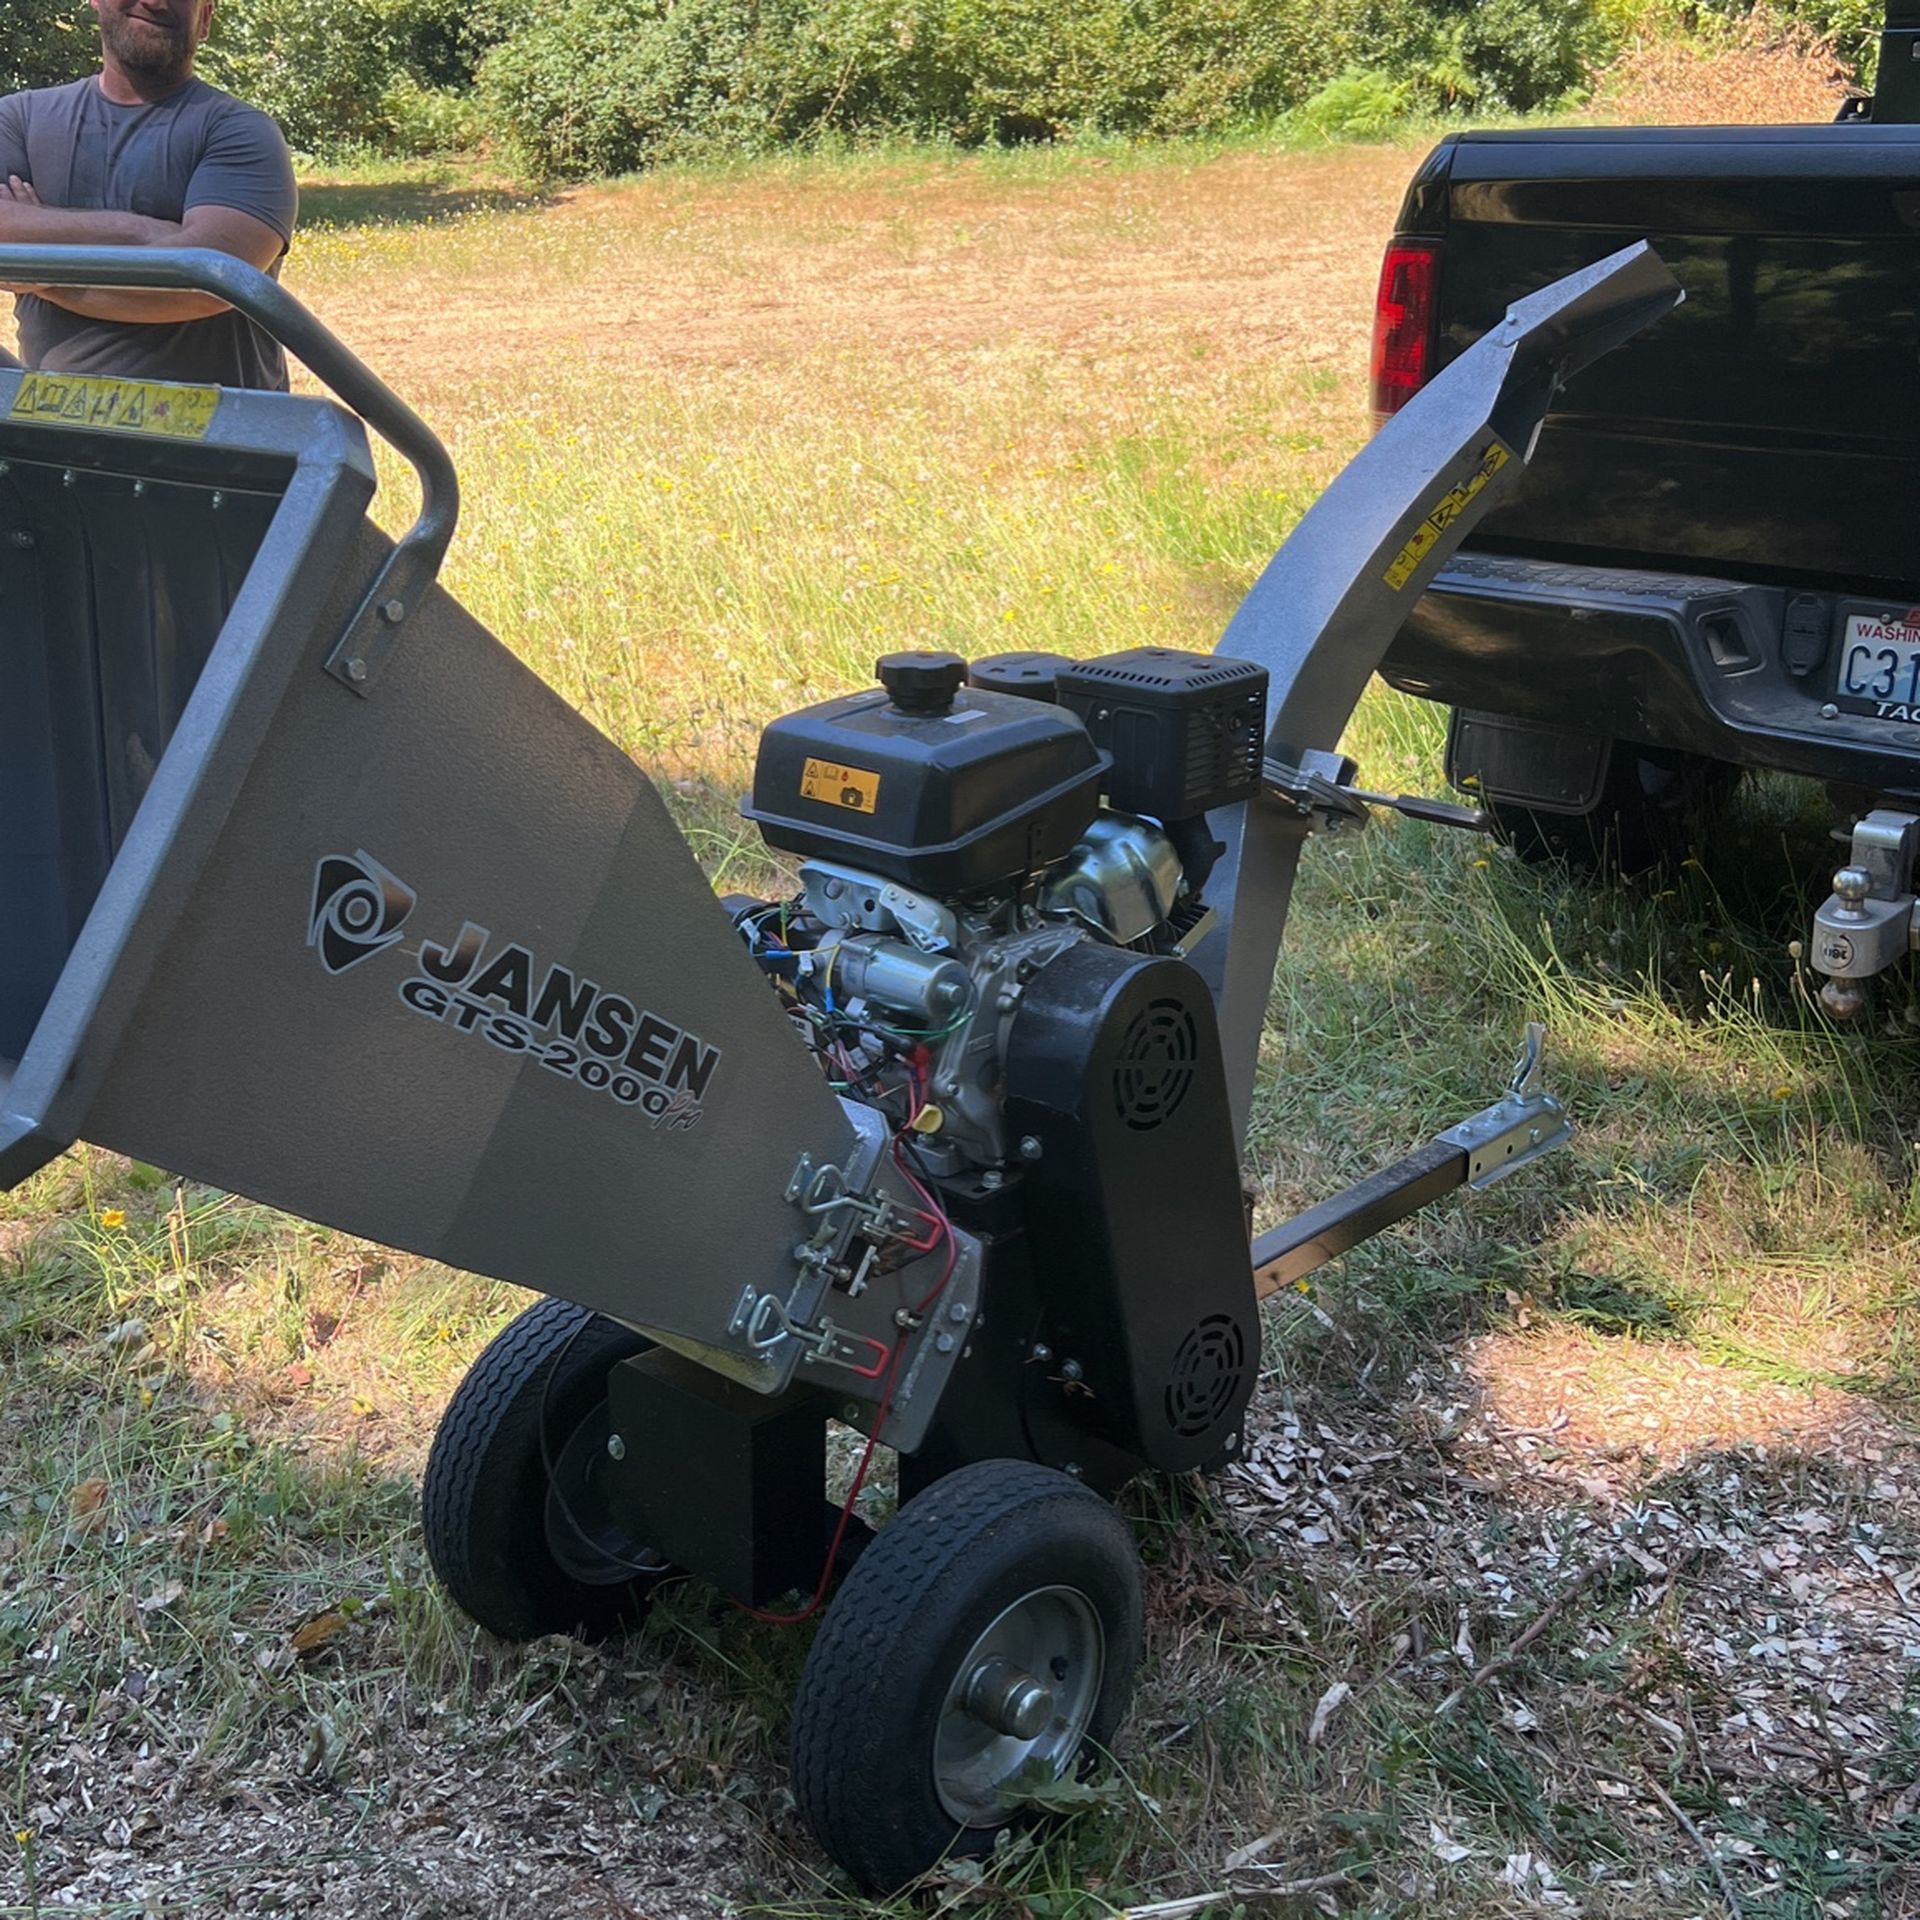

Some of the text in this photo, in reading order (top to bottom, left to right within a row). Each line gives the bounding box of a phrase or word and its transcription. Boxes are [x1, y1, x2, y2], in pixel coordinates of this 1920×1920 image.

[1845, 645, 1920, 703] C31
[399, 977, 672, 1119] GTS-2000
[418, 920, 722, 1104] JANSEN
